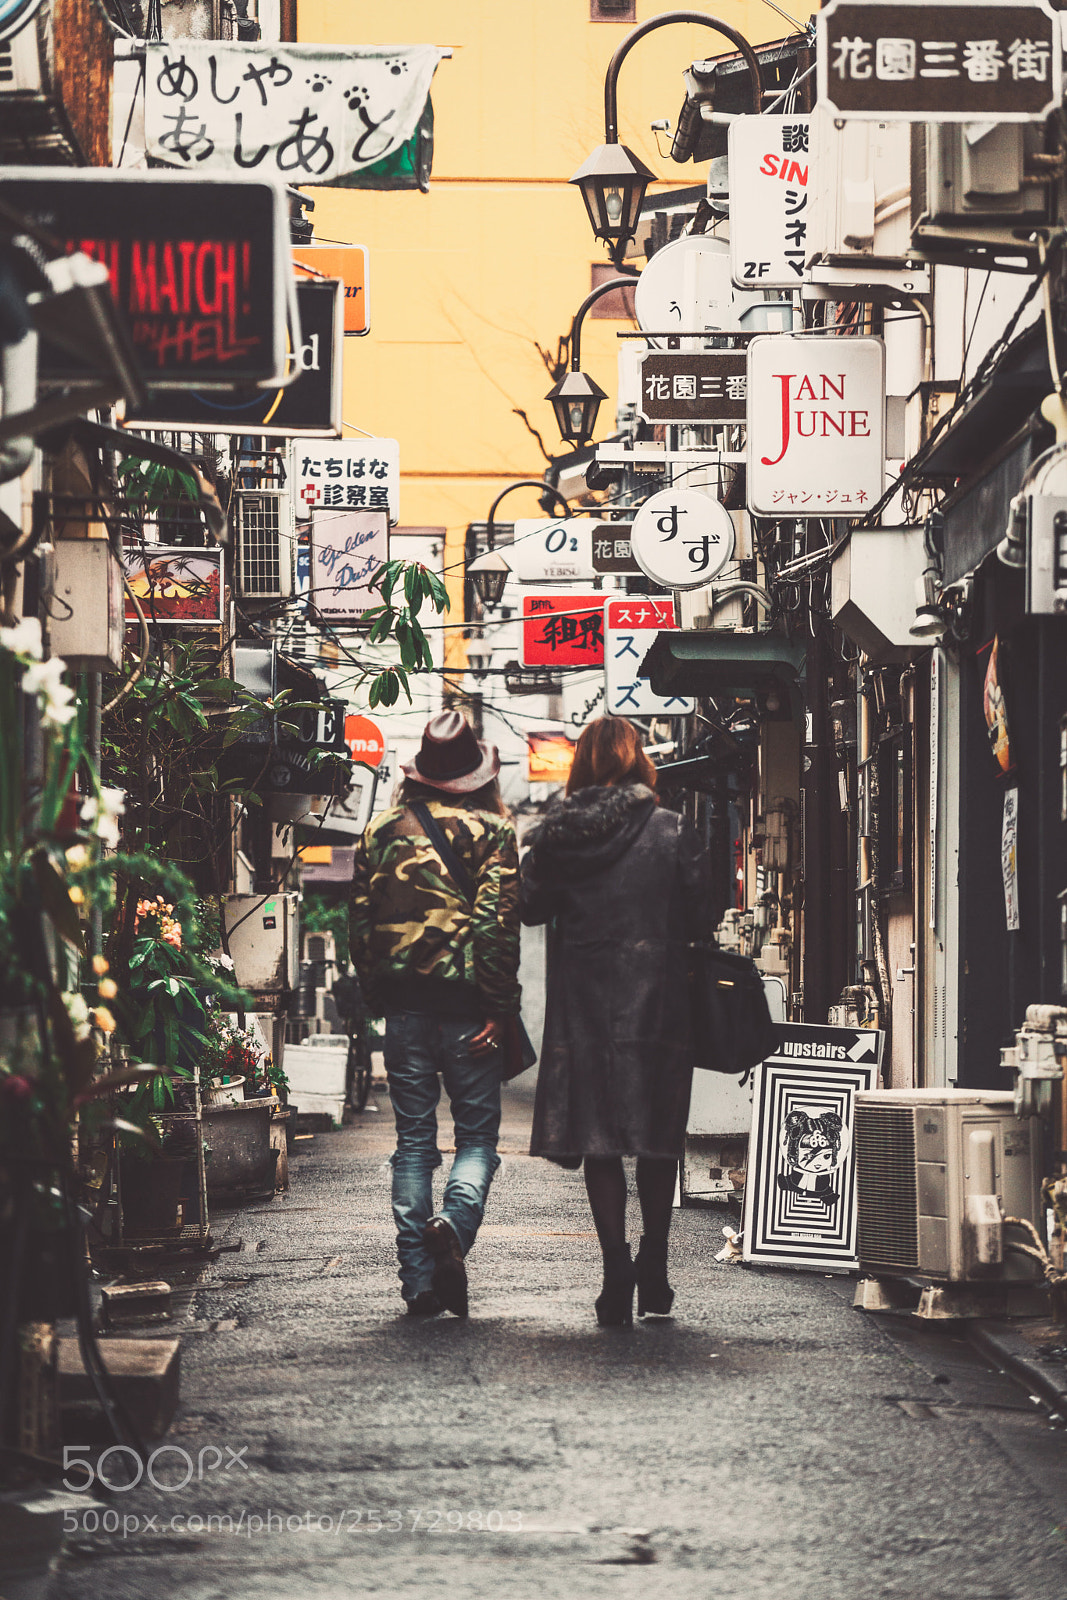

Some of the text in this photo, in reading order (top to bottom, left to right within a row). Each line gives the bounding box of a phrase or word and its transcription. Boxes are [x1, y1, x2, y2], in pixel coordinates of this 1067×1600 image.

[832, 37, 1050, 82] 花園三番街
[157, 56, 292, 106] めしや
[158, 106, 397, 175] あしあと
[744, 262, 771, 279] 2F
[302, 456, 389, 479] たちばな
[324, 484, 389, 506] 診察室
[771, 489, 869, 504] ジャン・ジュネ
[317, 530, 380, 577] Golden
[333, 554, 380, 596] Dust
[784, 1041, 847, 1060] upstairs
